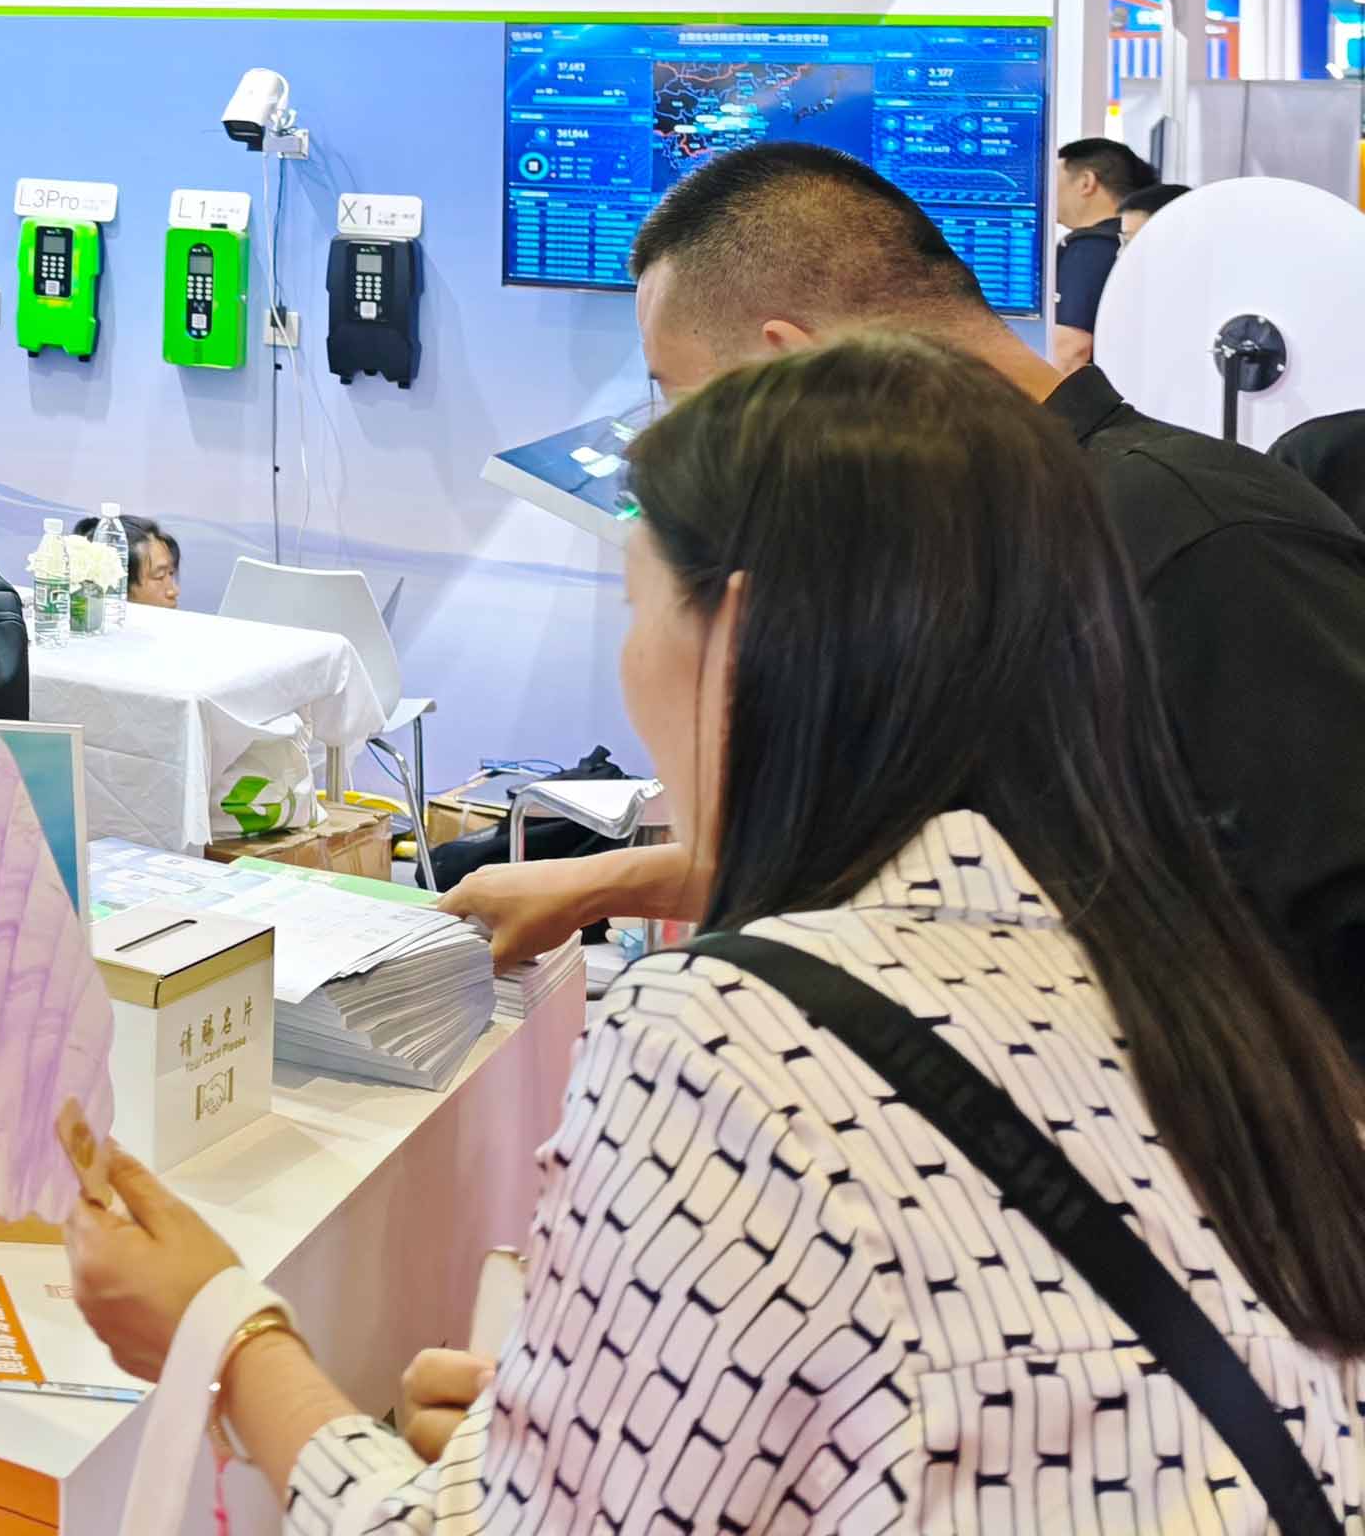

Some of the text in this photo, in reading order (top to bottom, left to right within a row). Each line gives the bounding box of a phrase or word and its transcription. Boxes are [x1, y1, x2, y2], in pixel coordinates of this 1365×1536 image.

[19, 185, 80, 210] L3Pro
[178, 197, 206, 223] L1
[340, 199, 372, 224] X1
